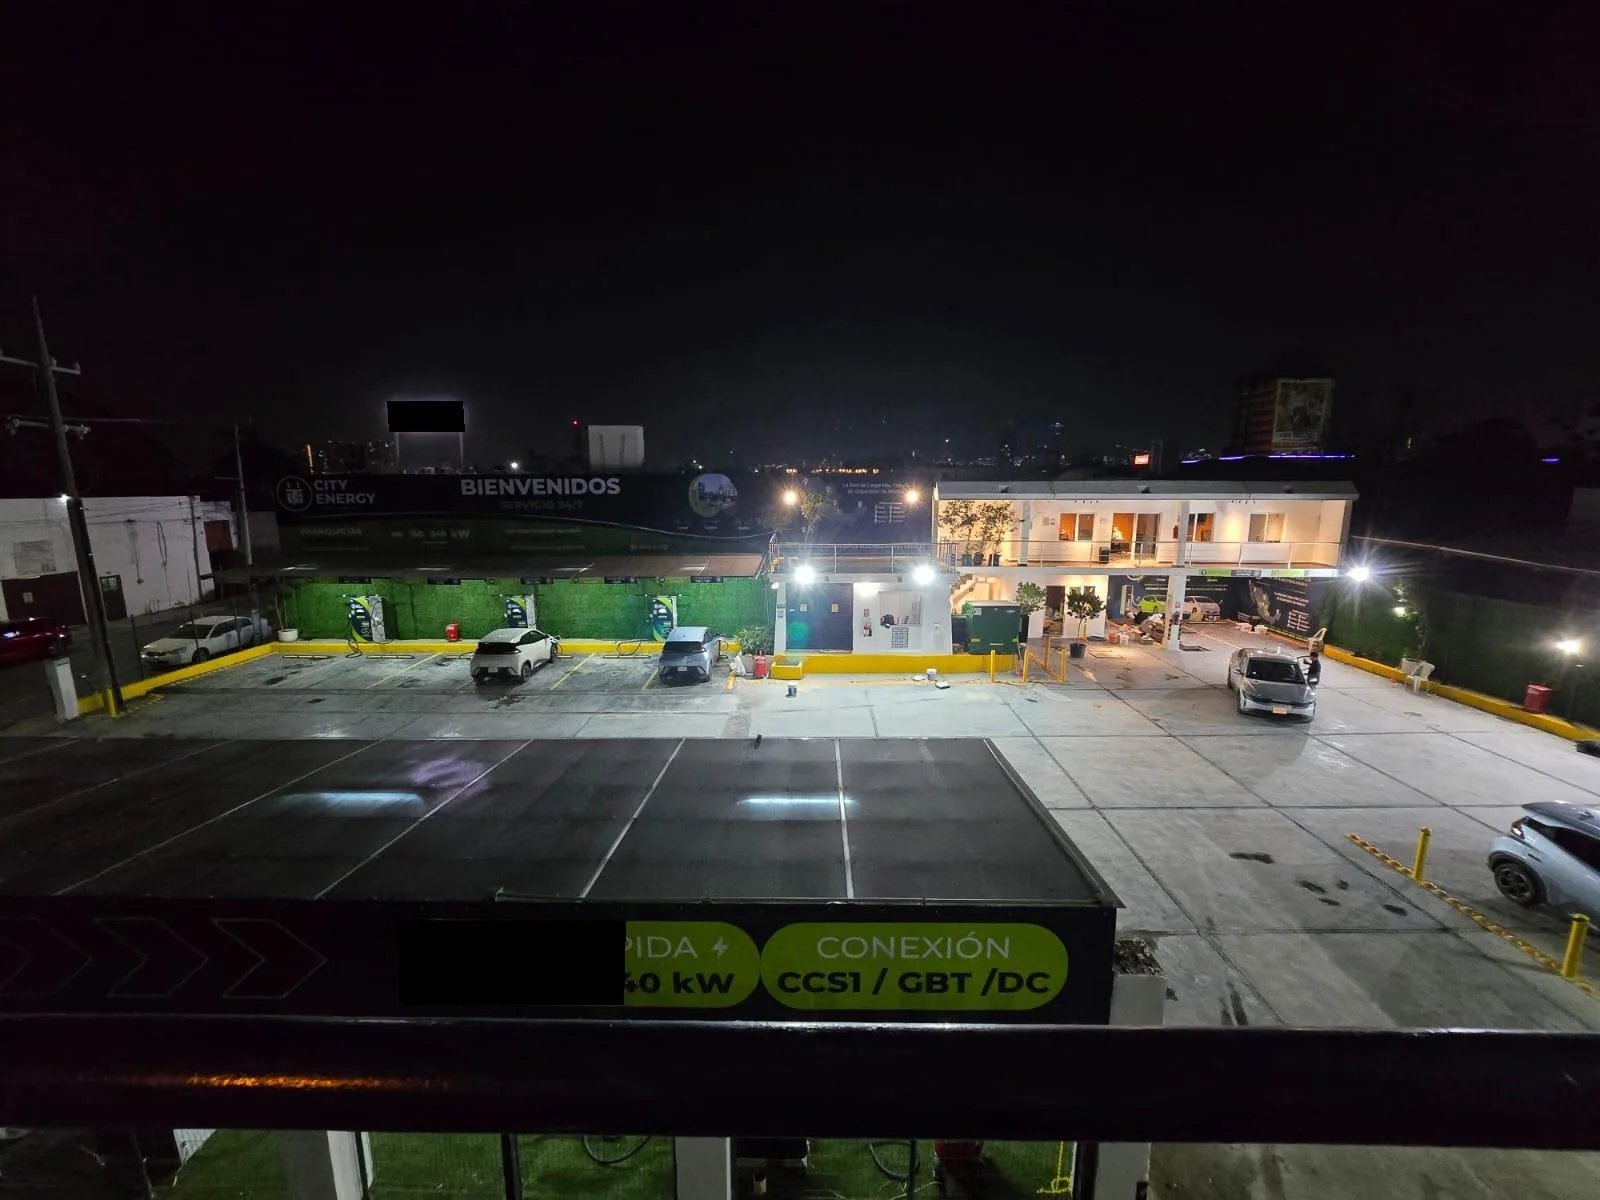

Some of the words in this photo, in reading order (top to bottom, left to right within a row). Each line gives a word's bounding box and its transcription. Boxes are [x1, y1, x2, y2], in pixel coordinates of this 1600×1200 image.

[313, 479, 348, 491] CITY
[459, 477, 621, 496] BIENVENIDOS
[315, 492, 376, 505] ENERGY
[499, 500, 555, 511] SERVICIO
[558, 500, 583, 511] 24/7
[816, 931, 1010, 960] CONEXIÓN
[672, 971, 735, 994] kW
[777, 971, 860, 994] CCS1
[871, 968, 889, 996] /
[898, 971, 972, 994] GBT
